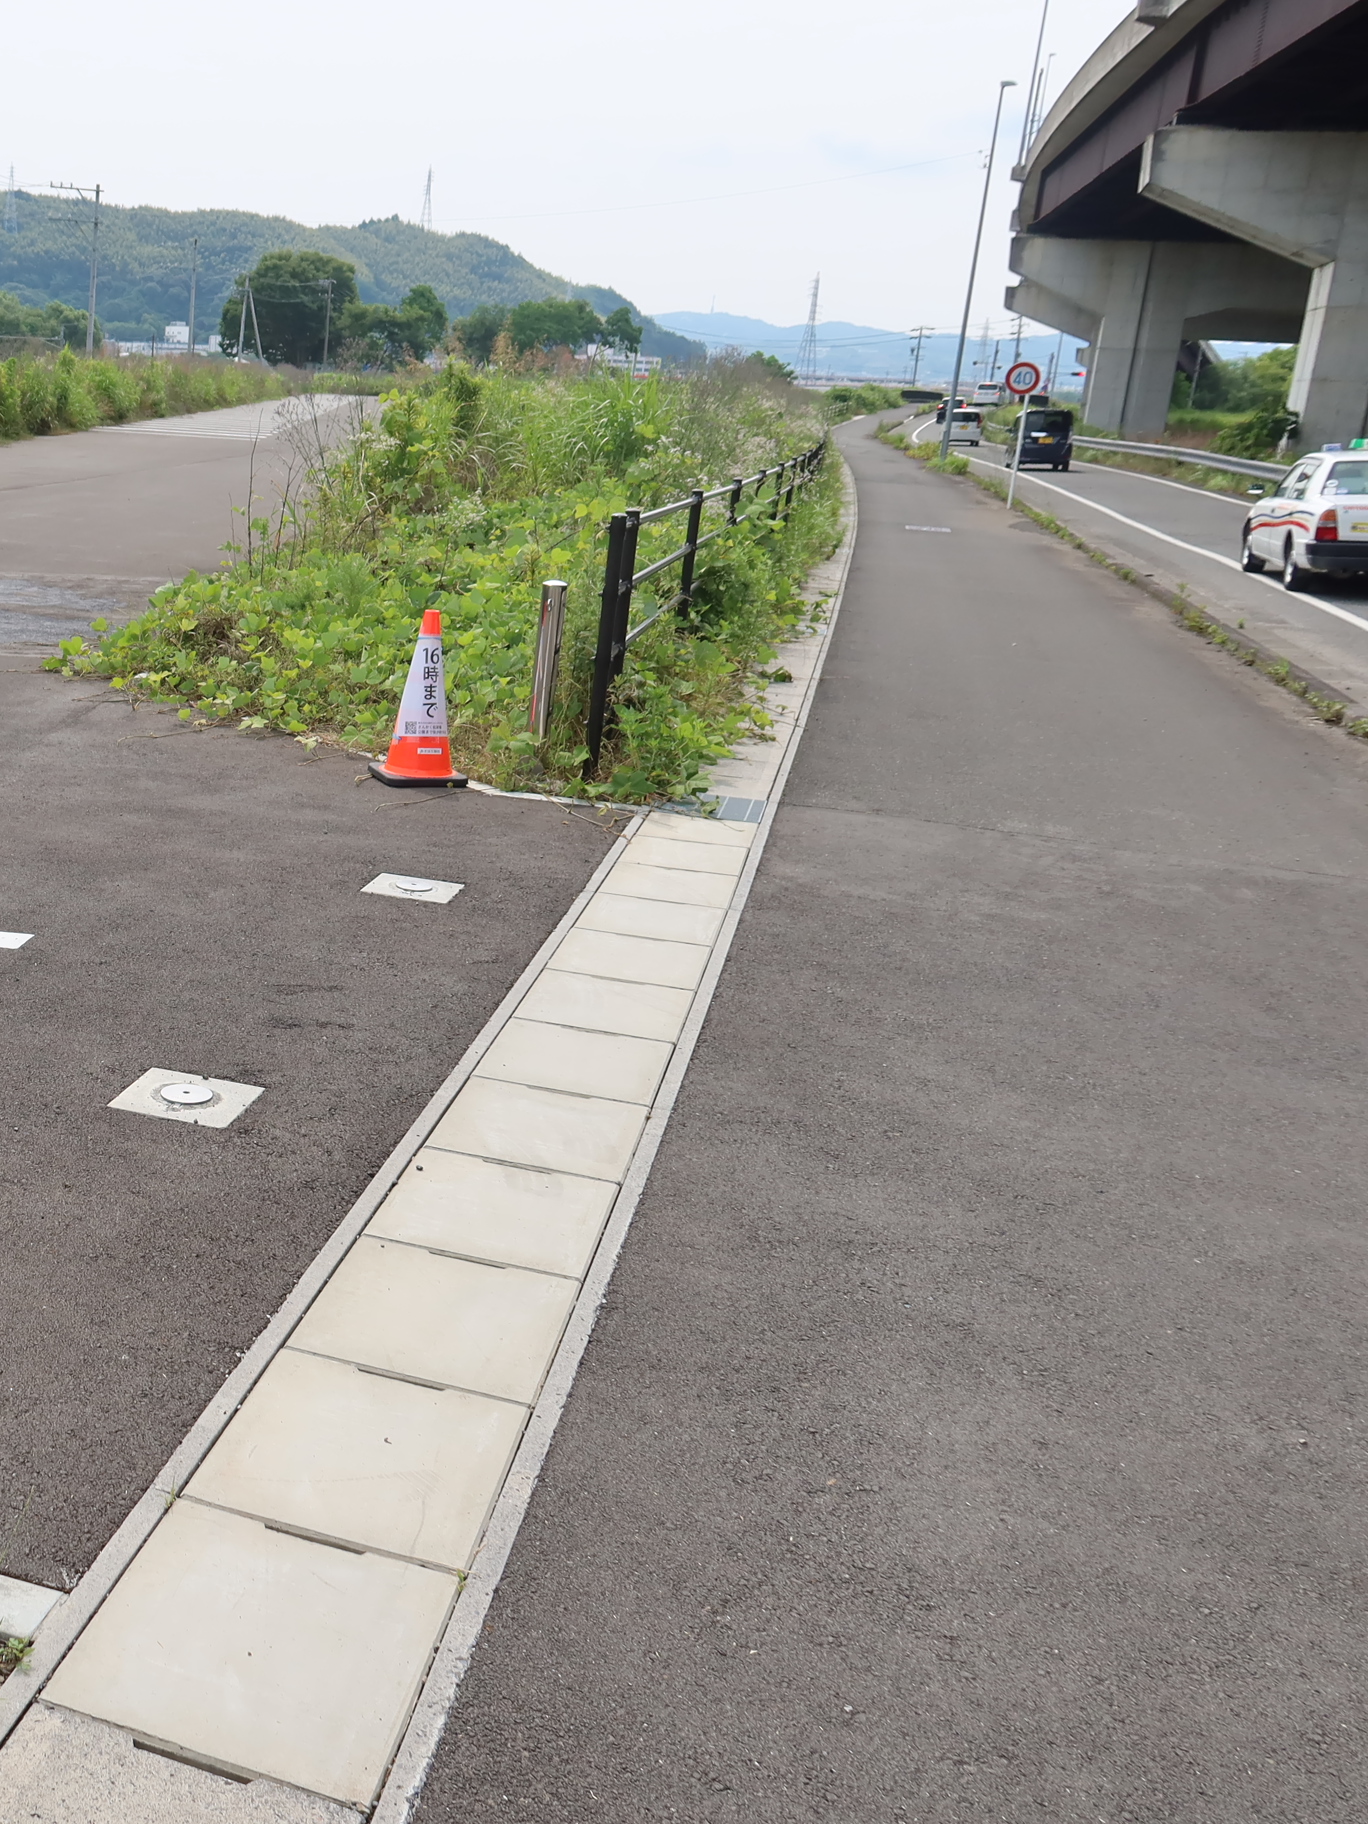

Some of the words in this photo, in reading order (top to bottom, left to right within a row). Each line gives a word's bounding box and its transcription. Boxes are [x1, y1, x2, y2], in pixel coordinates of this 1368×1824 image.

[1013, 371, 1034, 386] 40
[422, 647, 440, 719] 16時まで
